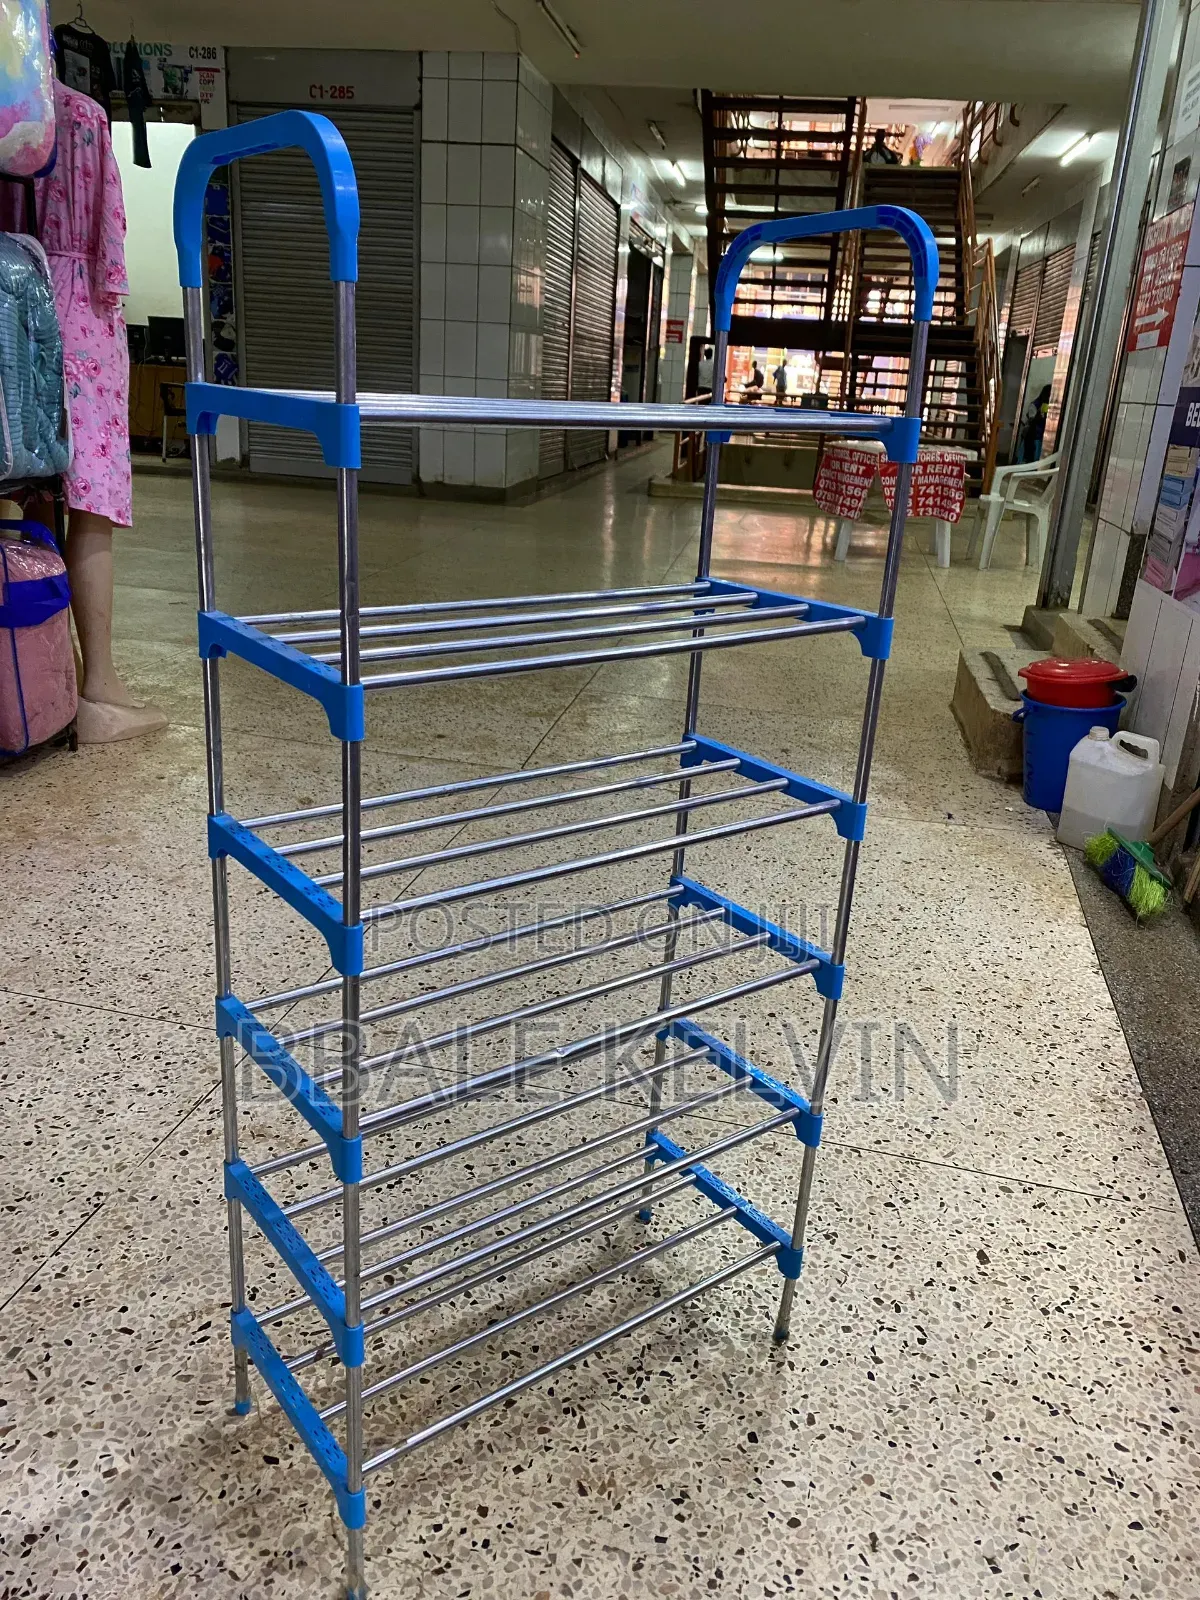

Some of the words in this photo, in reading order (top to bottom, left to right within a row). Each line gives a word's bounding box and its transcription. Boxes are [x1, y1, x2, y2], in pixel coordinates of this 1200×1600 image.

[188, 46, 217, 60] C1-286
[309, 84, 355, 100] C1-285
[917, 452, 943, 463] TORES,
[927, 464, 961, 476] RENT
[919, 485, 964, 501] 741566
